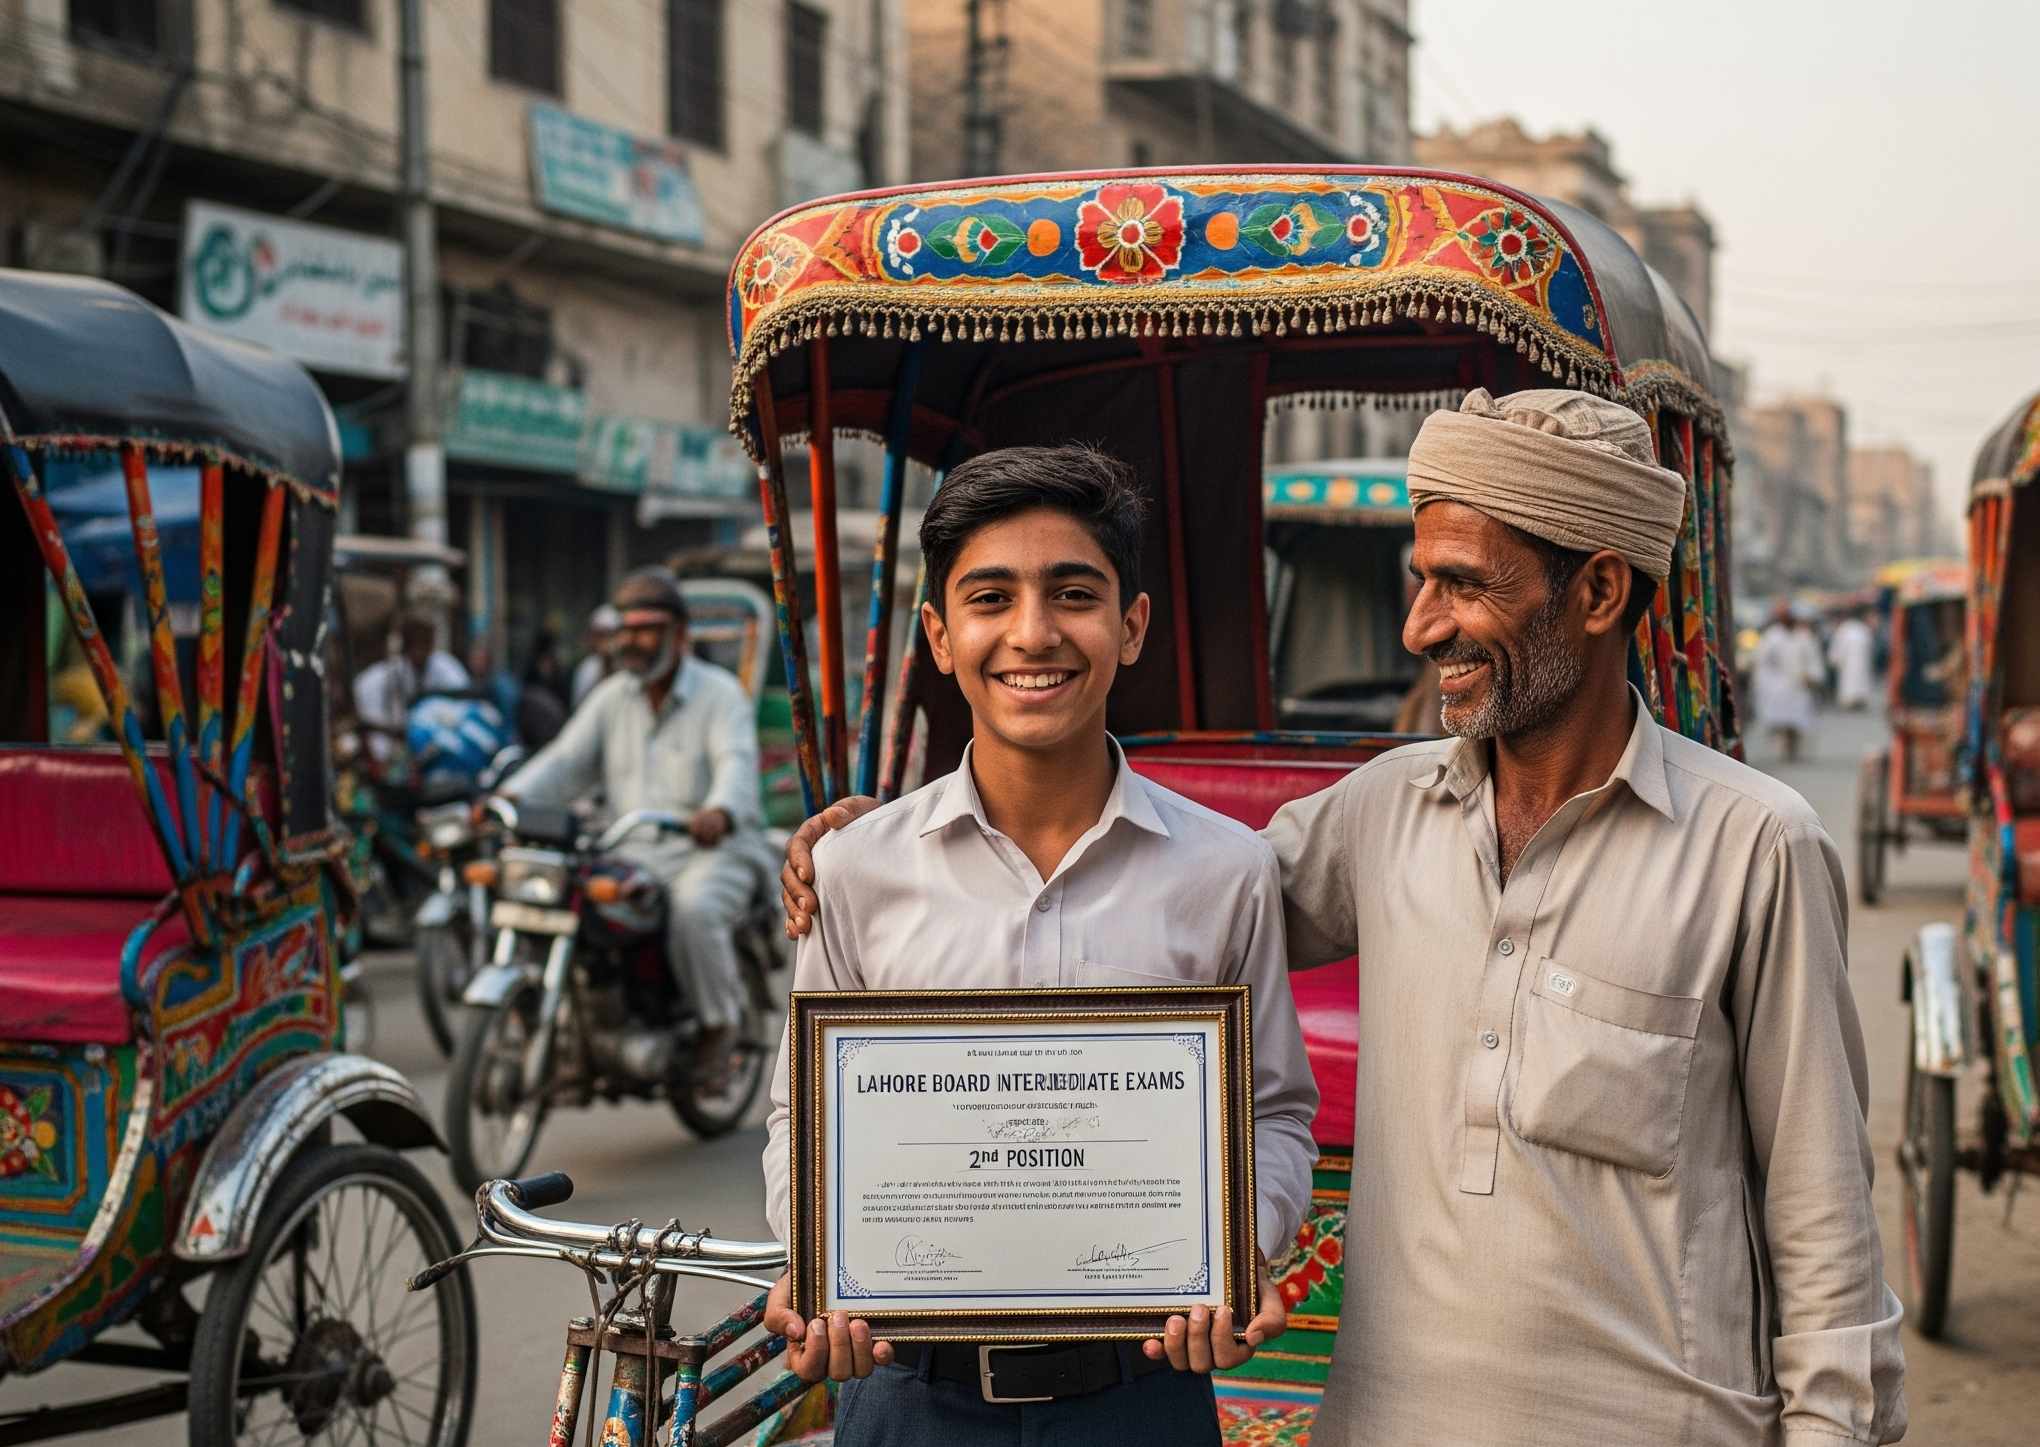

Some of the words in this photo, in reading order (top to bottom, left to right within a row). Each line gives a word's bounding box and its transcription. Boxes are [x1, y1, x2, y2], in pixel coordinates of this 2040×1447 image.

[857, 1074, 928, 1093] LAHORE
[932, 1073, 990, 1093] BOARD
[1126, 1070, 1185, 1091] EXAMS
[969, 1149, 999, 1169] 2nd
[1007, 1148, 1085, 1168] POSITION
